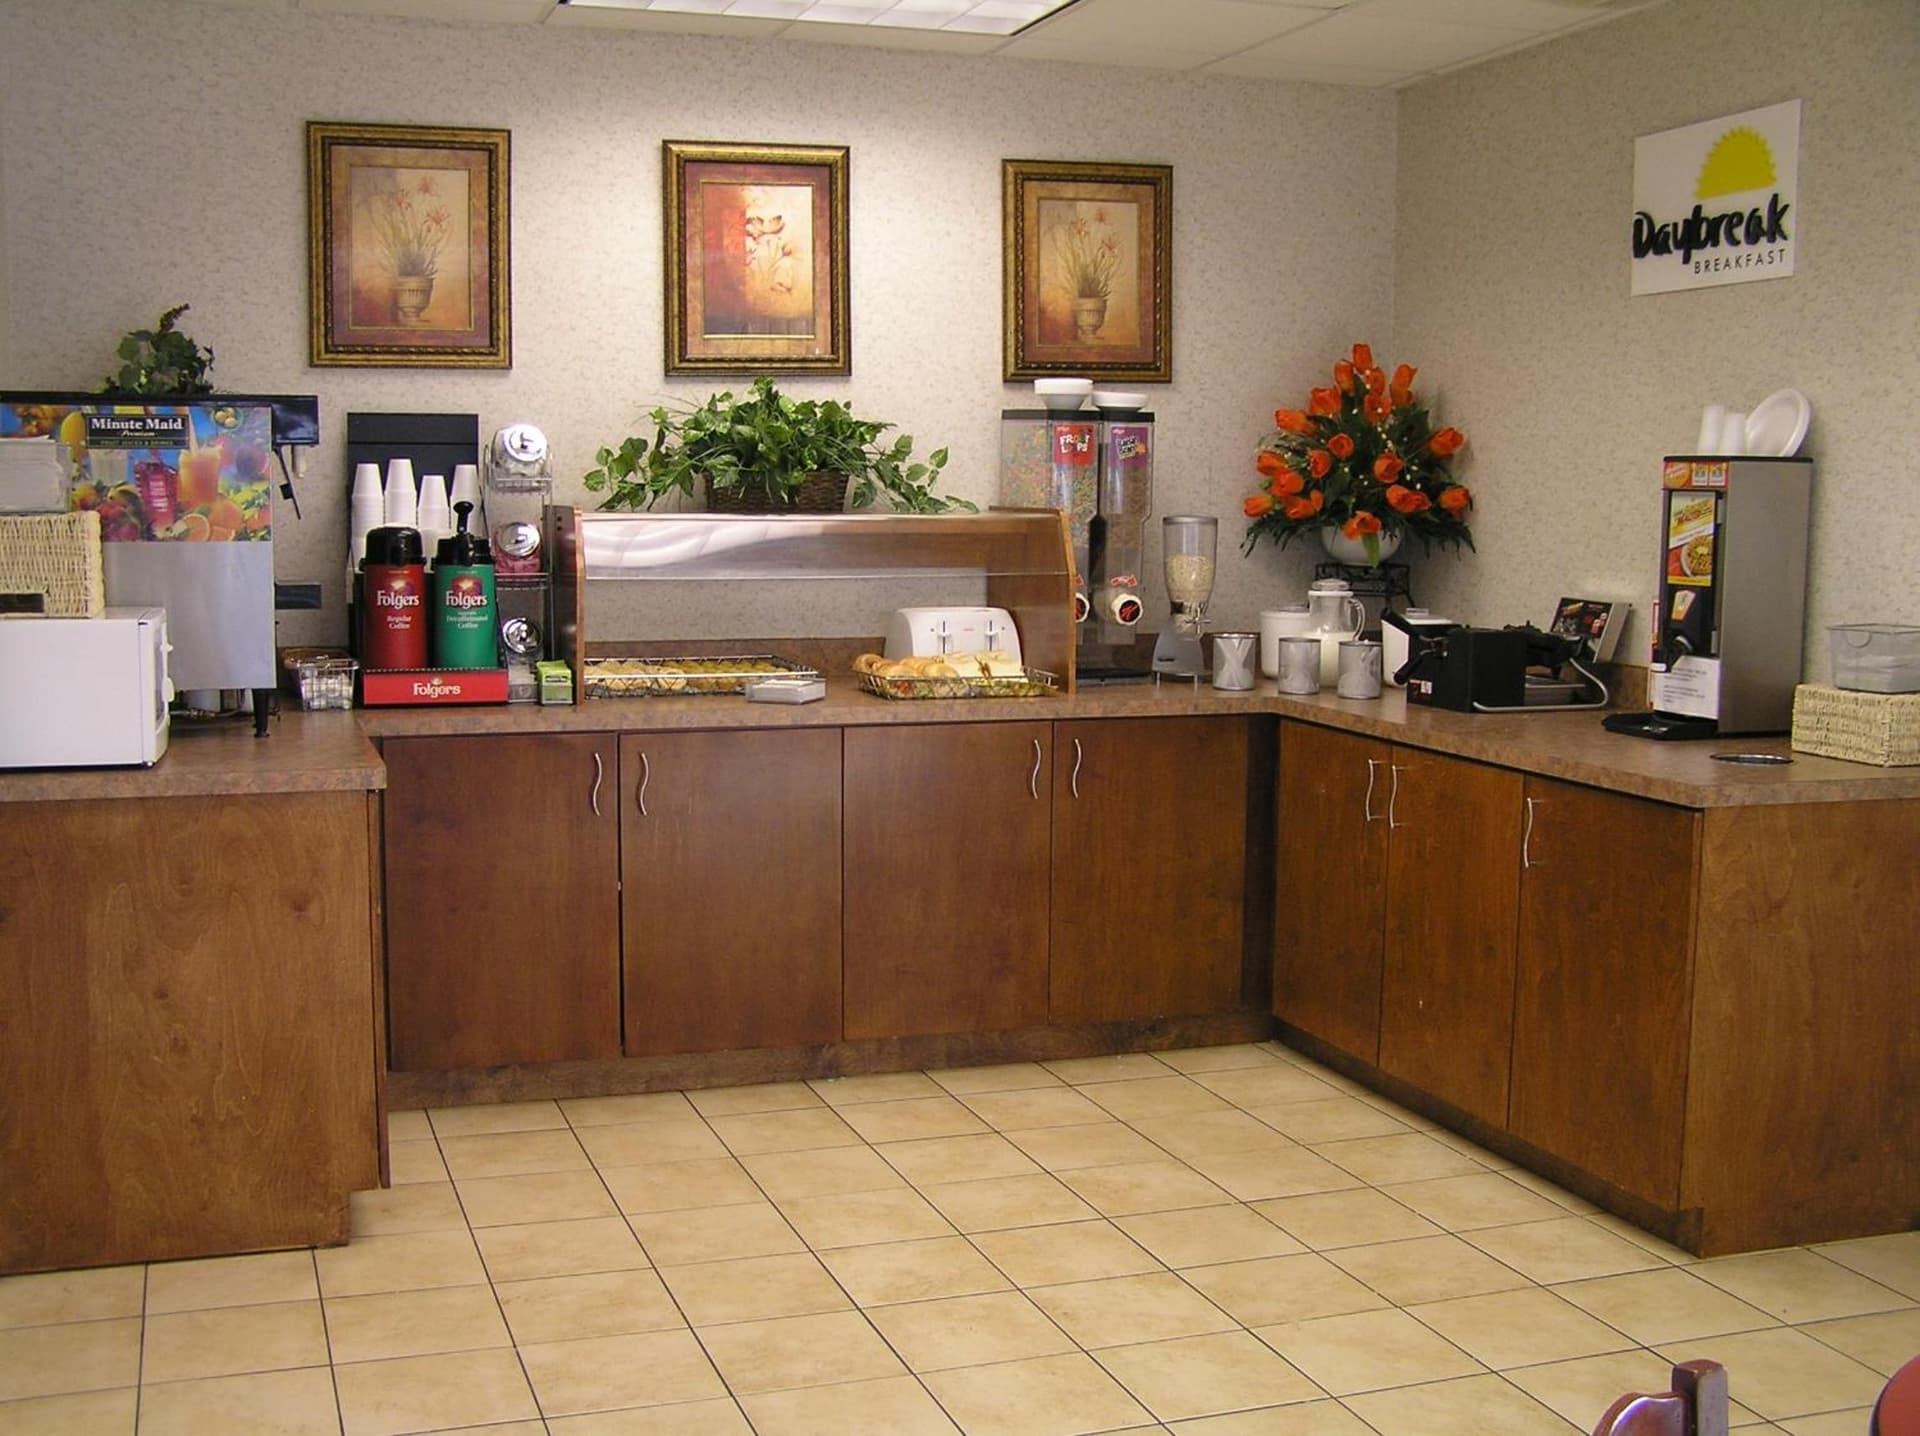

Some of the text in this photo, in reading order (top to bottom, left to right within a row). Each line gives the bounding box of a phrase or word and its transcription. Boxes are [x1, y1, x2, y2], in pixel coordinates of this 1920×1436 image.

[1632, 193, 1790, 265] Daybreak
[1693, 249, 1786, 274] BREAKFAST
[91, 418, 183, 429] Minute Maid
[377, 590, 420, 609] Folgers
[446, 590, 488, 609] Folgers
[413, 682, 461, 699] Folgers
